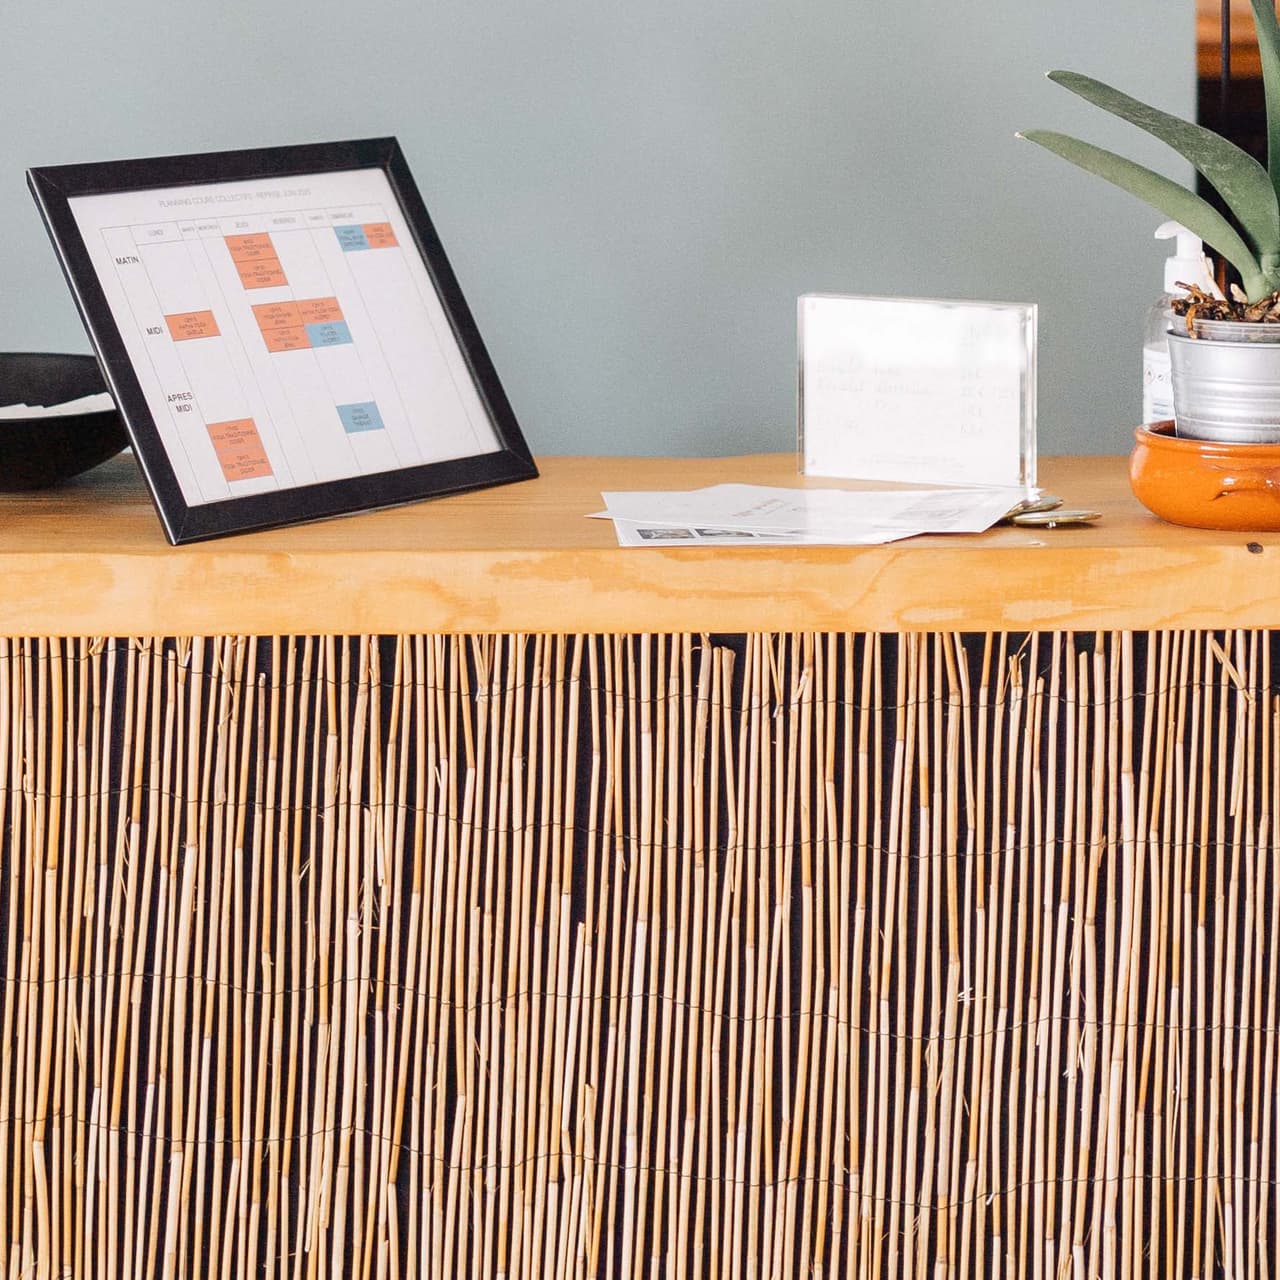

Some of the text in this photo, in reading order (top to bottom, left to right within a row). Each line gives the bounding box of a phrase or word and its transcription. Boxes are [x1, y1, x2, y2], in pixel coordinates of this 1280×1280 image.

[115, 256, 141, 266] MATIN
[146, 326, 164, 337] MIDI
[167, 391, 194, 403] APRES
[175, 403, 193, 414] MIDI
